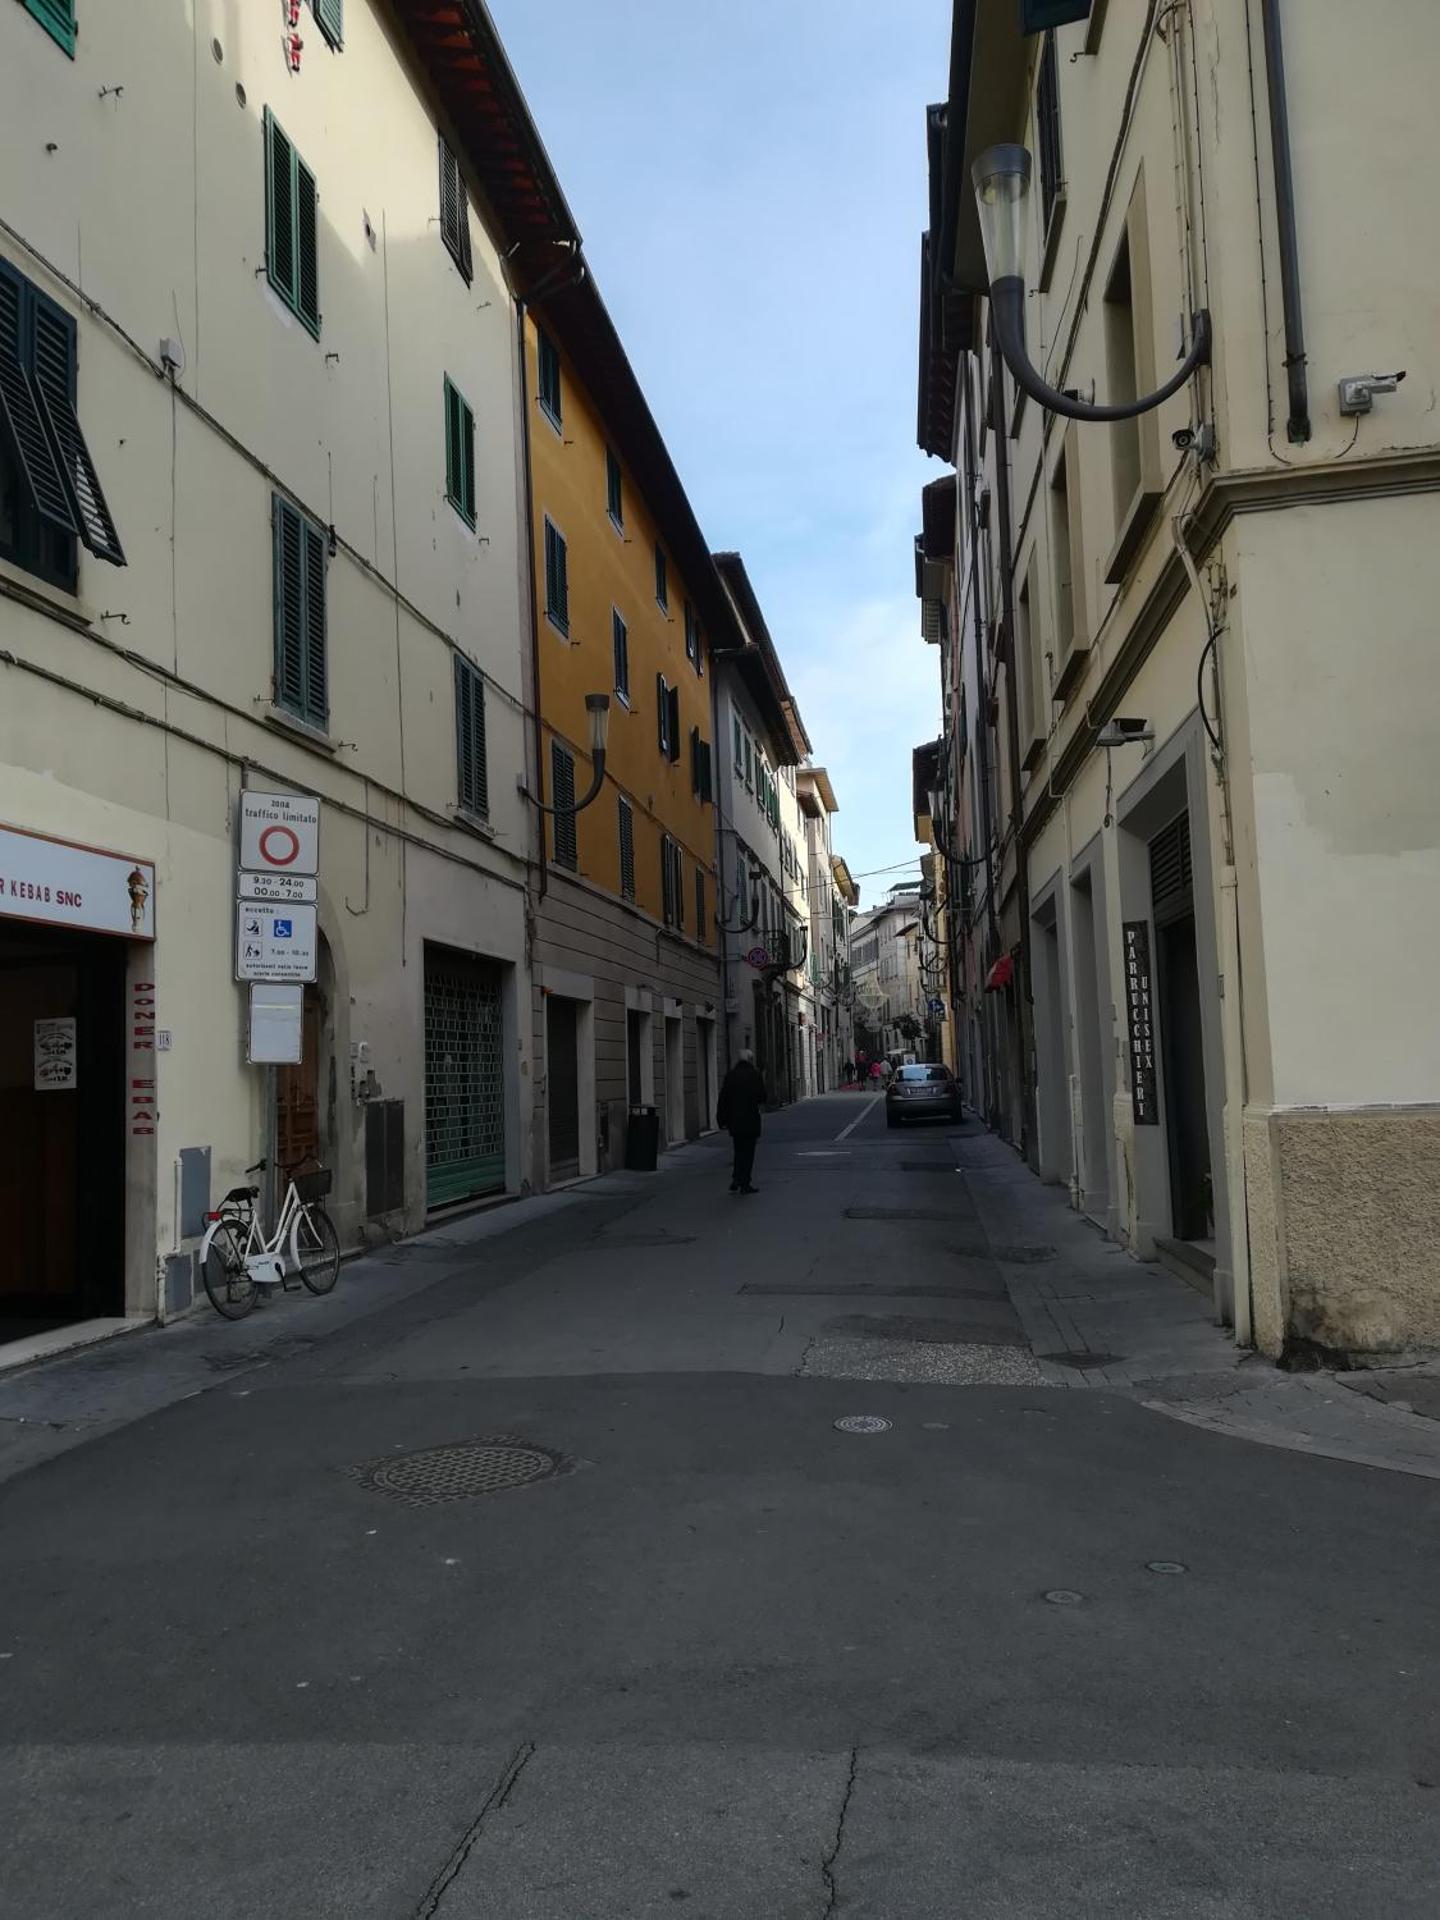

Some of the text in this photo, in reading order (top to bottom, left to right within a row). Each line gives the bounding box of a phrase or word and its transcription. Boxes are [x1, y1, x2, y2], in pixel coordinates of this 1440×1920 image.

[271, 800, 290, 809] zona
[245, 808, 317, 824] traffico limitato
[10, 879, 51, 903] KEBAB
[55, 890, 82, 908] SNC
[254, 886, 280, 897] 00.00
[279, 877, 304, 888] 24.00
[133, 983, 155, 1050] DONER
[1127, 931, 1145, 1116] PARRUCCHIERI
[1141, 976, 1153, 1069] UNISEX
